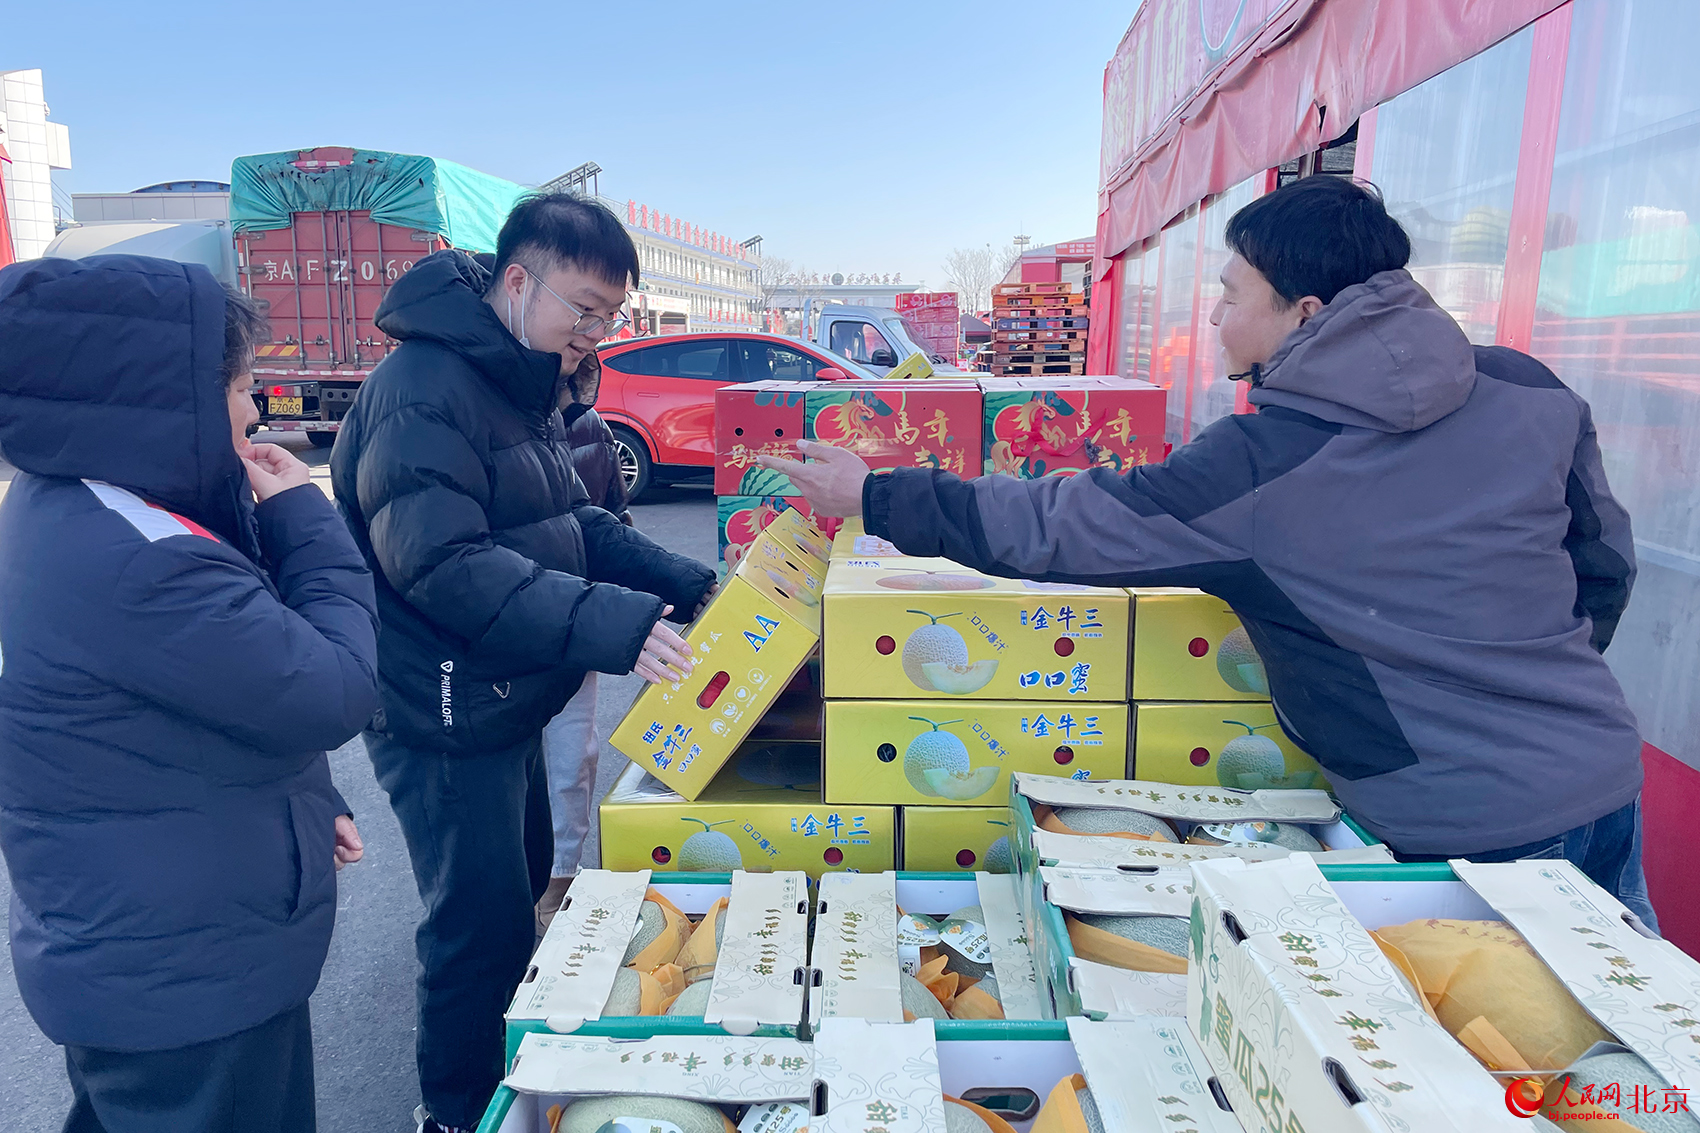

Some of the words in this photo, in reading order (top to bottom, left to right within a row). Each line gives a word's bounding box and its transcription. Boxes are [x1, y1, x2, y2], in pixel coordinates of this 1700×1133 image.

[269, 403, 301, 413] FZ069
[894, 409, 949, 447] 马年
[913, 445, 966, 474] 吉祥
[742, 614, 780, 653] AA
[1030, 606, 1103, 631] 金牛三
[1019, 662, 1091, 695] 口口蜜
[441, 673, 453, 725] PRIMALOFT
[1031, 713, 1103, 738] 金牛三
[652, 723, 693, 771] 金牛三
[800, 813, 871, 838] 金牛三
